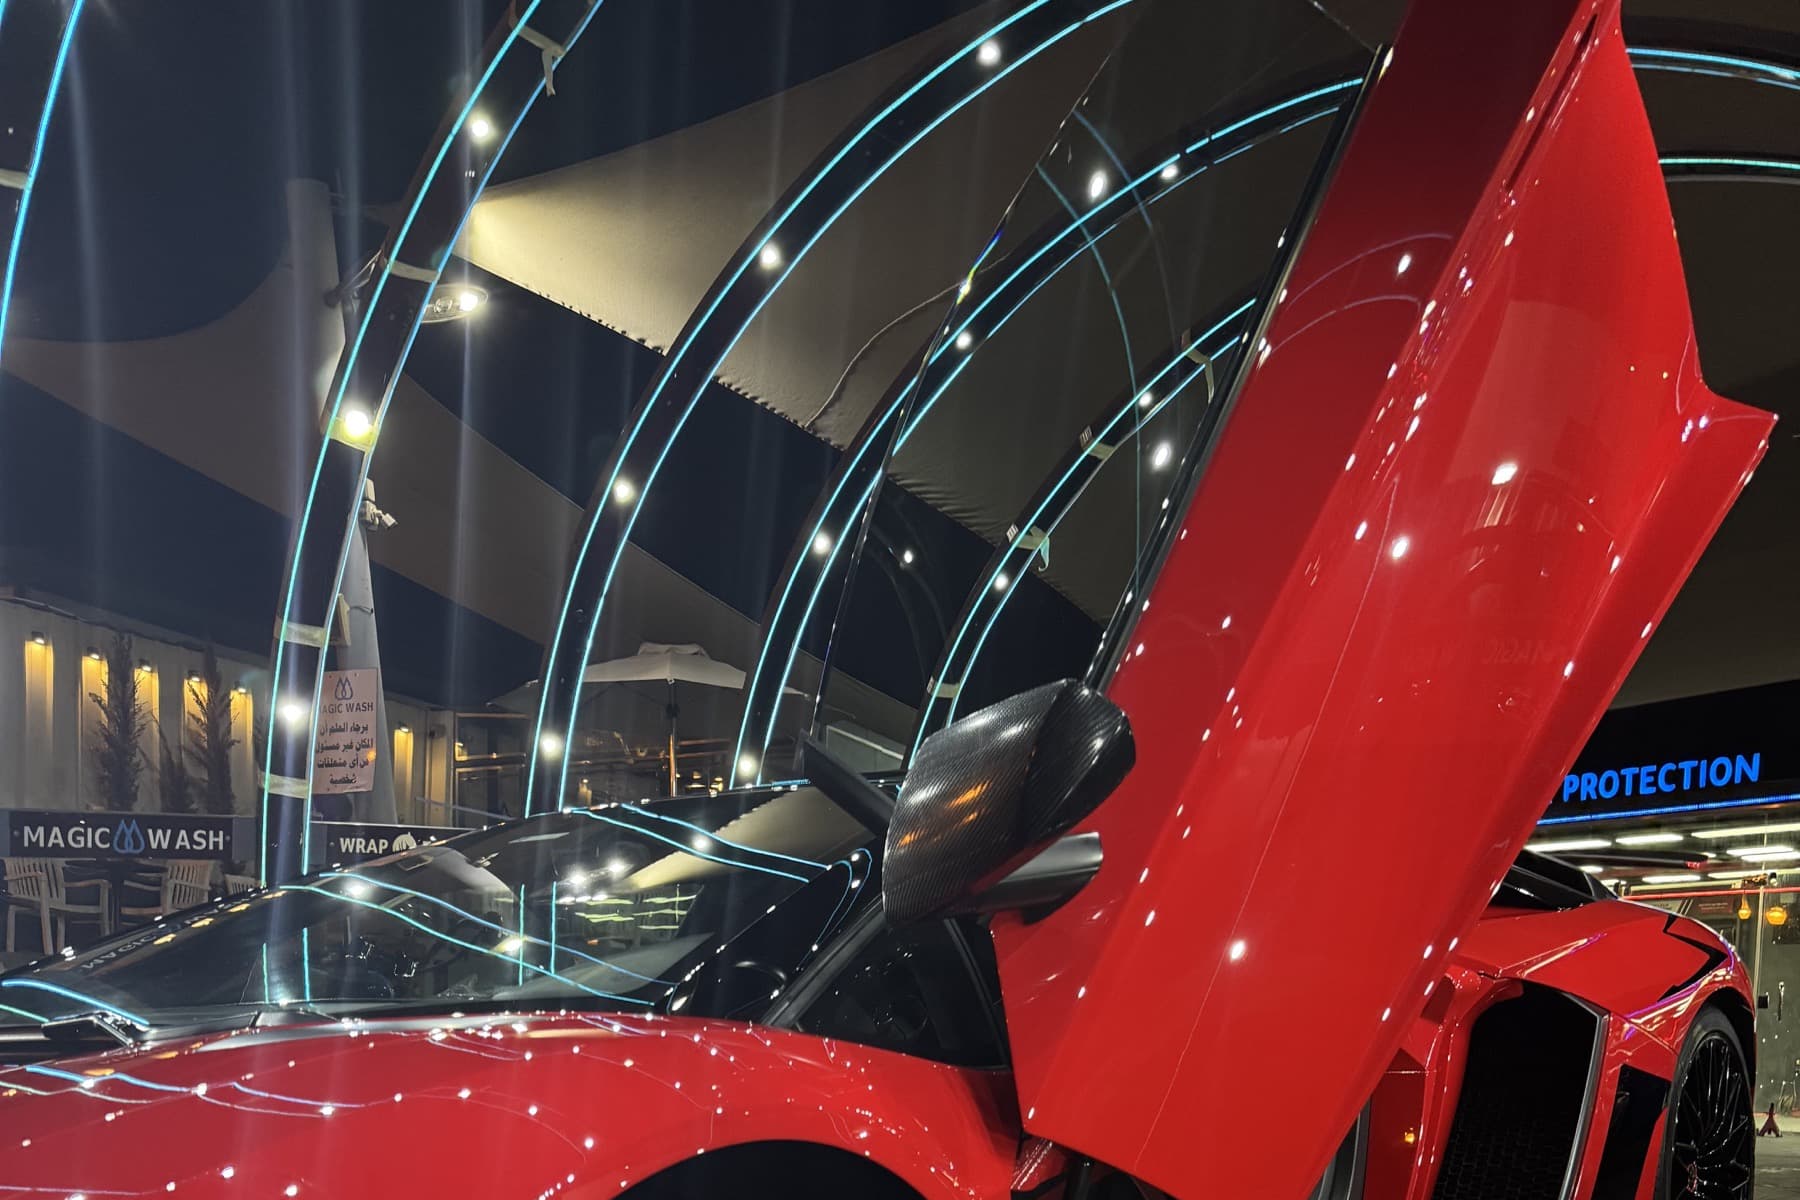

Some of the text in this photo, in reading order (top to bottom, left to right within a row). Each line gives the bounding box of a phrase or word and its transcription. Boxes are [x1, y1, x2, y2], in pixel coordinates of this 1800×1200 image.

[319, 702, 373, 713] AGIC WASH
[320, 721, 328, 736] أن
[329, 722, 348, 735] العلم
[341, 740, 353, 753] غير
[355, 738, 373, 751] المكان
[317, 756, 347, 768] متعلقات
[329, 773, 357, 785] شخصية
[1562, 752, 1762, 802] PROTECTION
[23, 825, 224, 851] MAGIC WASH
[339, 837, 389, 854] WRAP
